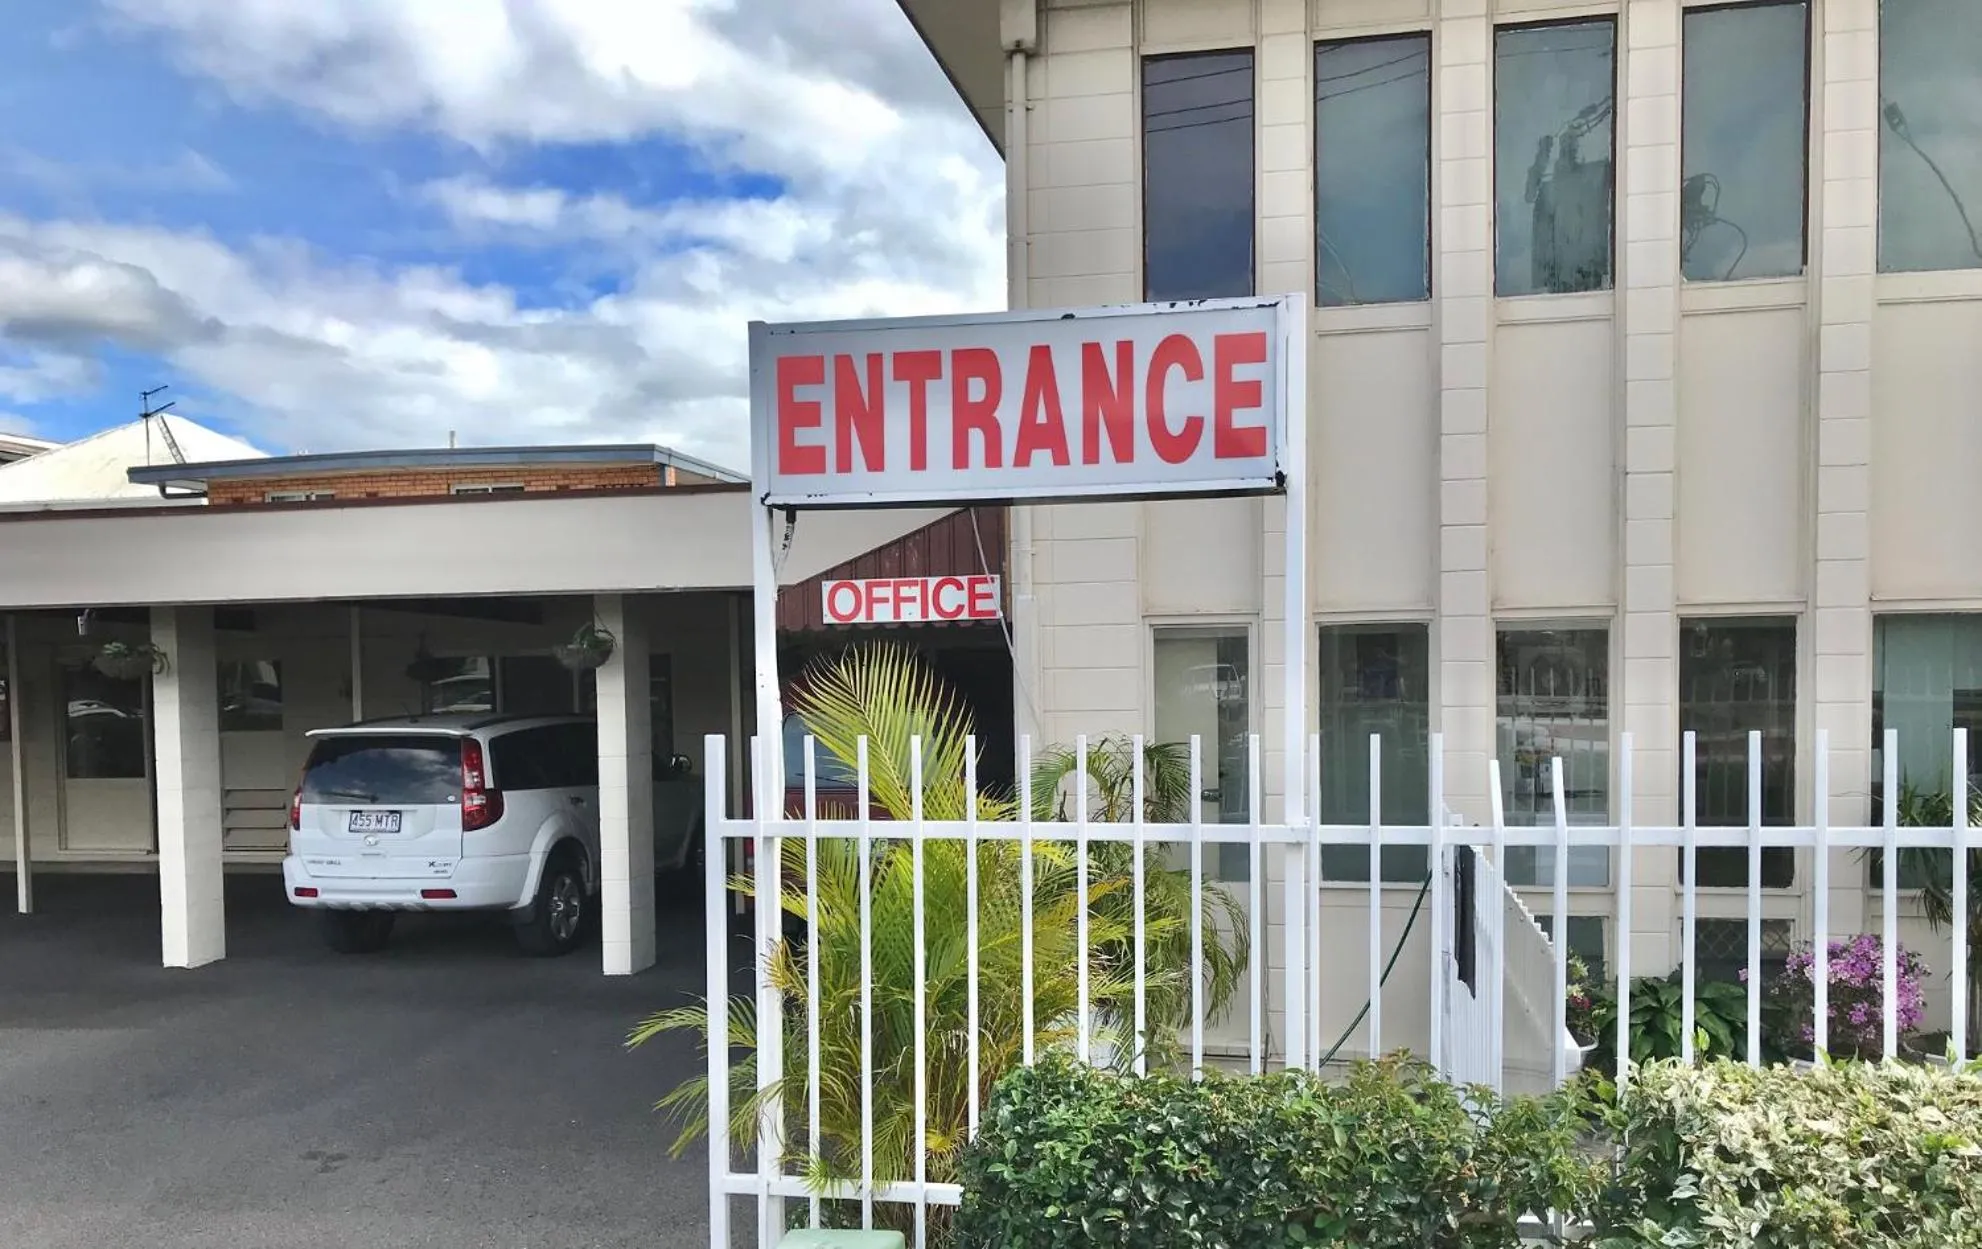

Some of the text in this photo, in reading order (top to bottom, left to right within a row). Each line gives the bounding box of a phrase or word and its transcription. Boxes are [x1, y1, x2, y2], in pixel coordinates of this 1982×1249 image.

[776, 331, 1267, 475] ENTRANCE
[827, 576, 997, 622] OFFICE
[351, 812, 398, 828] 455 MTR
